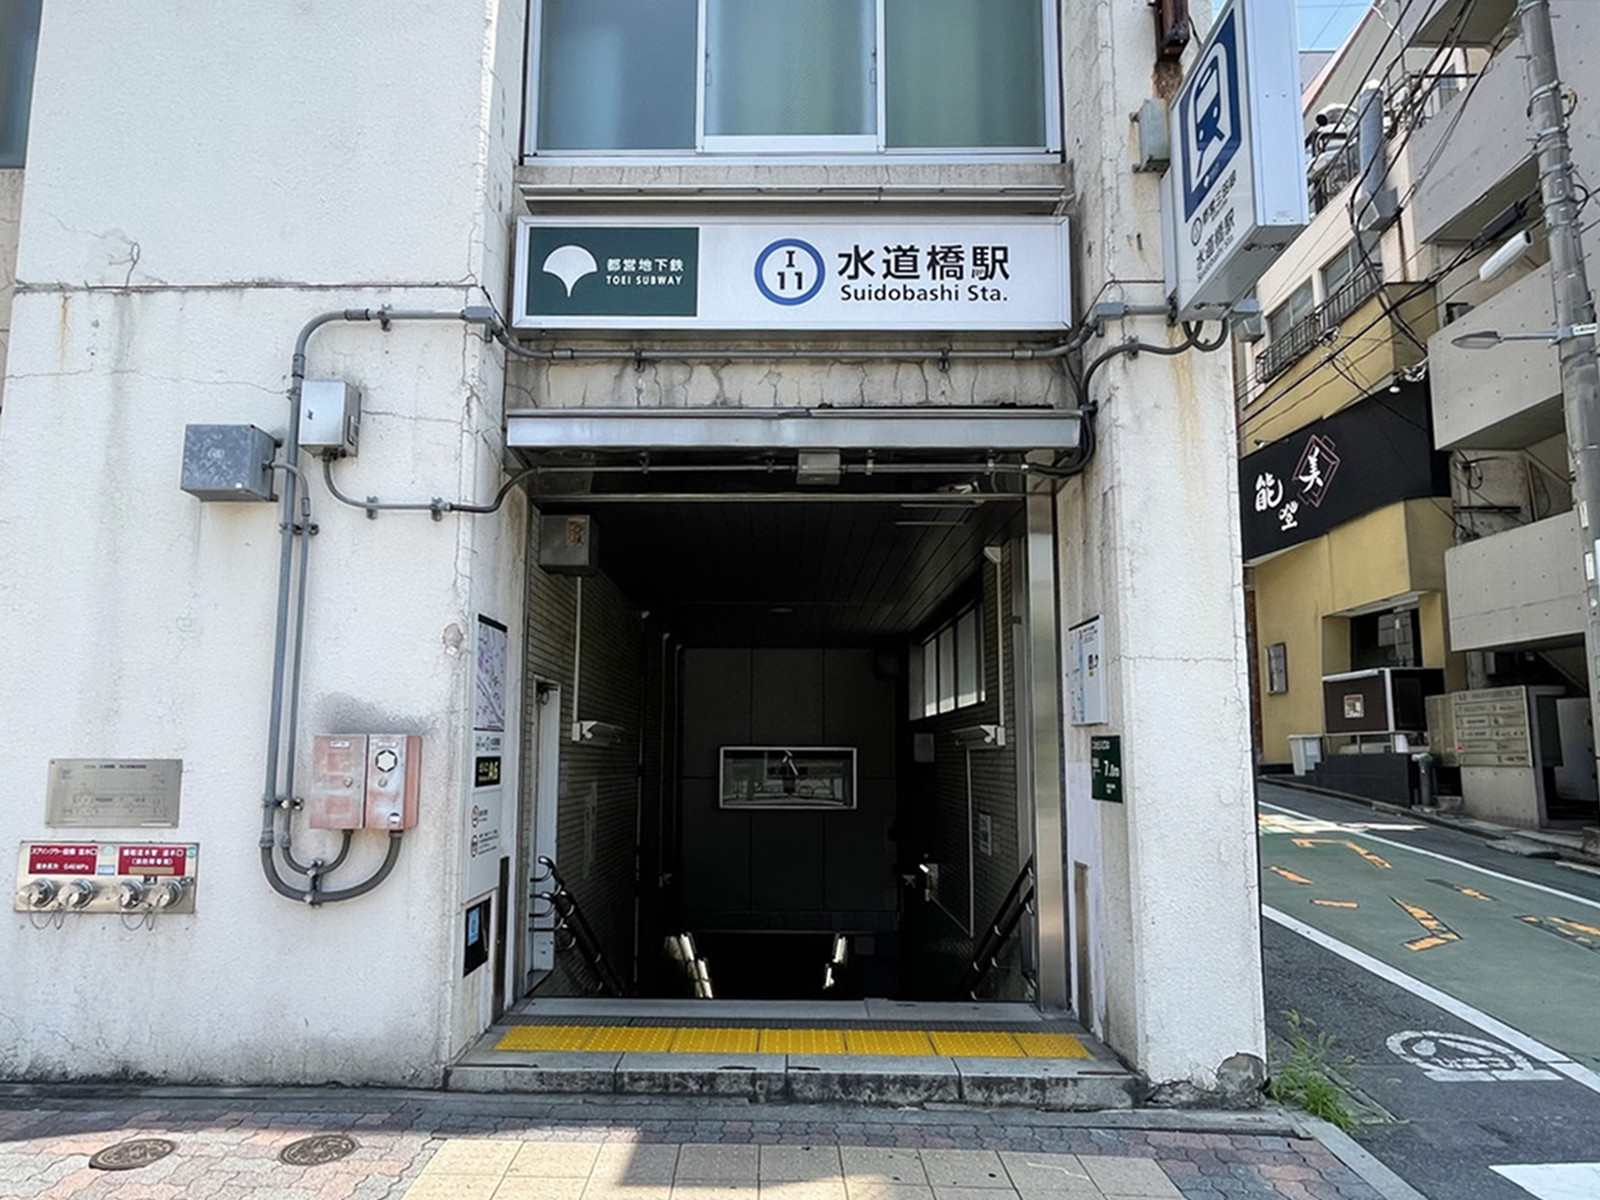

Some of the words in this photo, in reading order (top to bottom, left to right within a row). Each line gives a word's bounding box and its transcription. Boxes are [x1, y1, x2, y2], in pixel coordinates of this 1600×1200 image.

[607, 259, 684, 272] 都営地下鉄
[786, 250, 796, 268] I
[838, 244, 1010, 281] 水道橋駅
[606, 275, 631, 286] TOEI
[636, 275, 683, 286] SUBWAY
[777, 271, 803, 291] 11
[840, 283, 959, 302] Suidobashi
[967, 284, 1008, 302] Sta.
